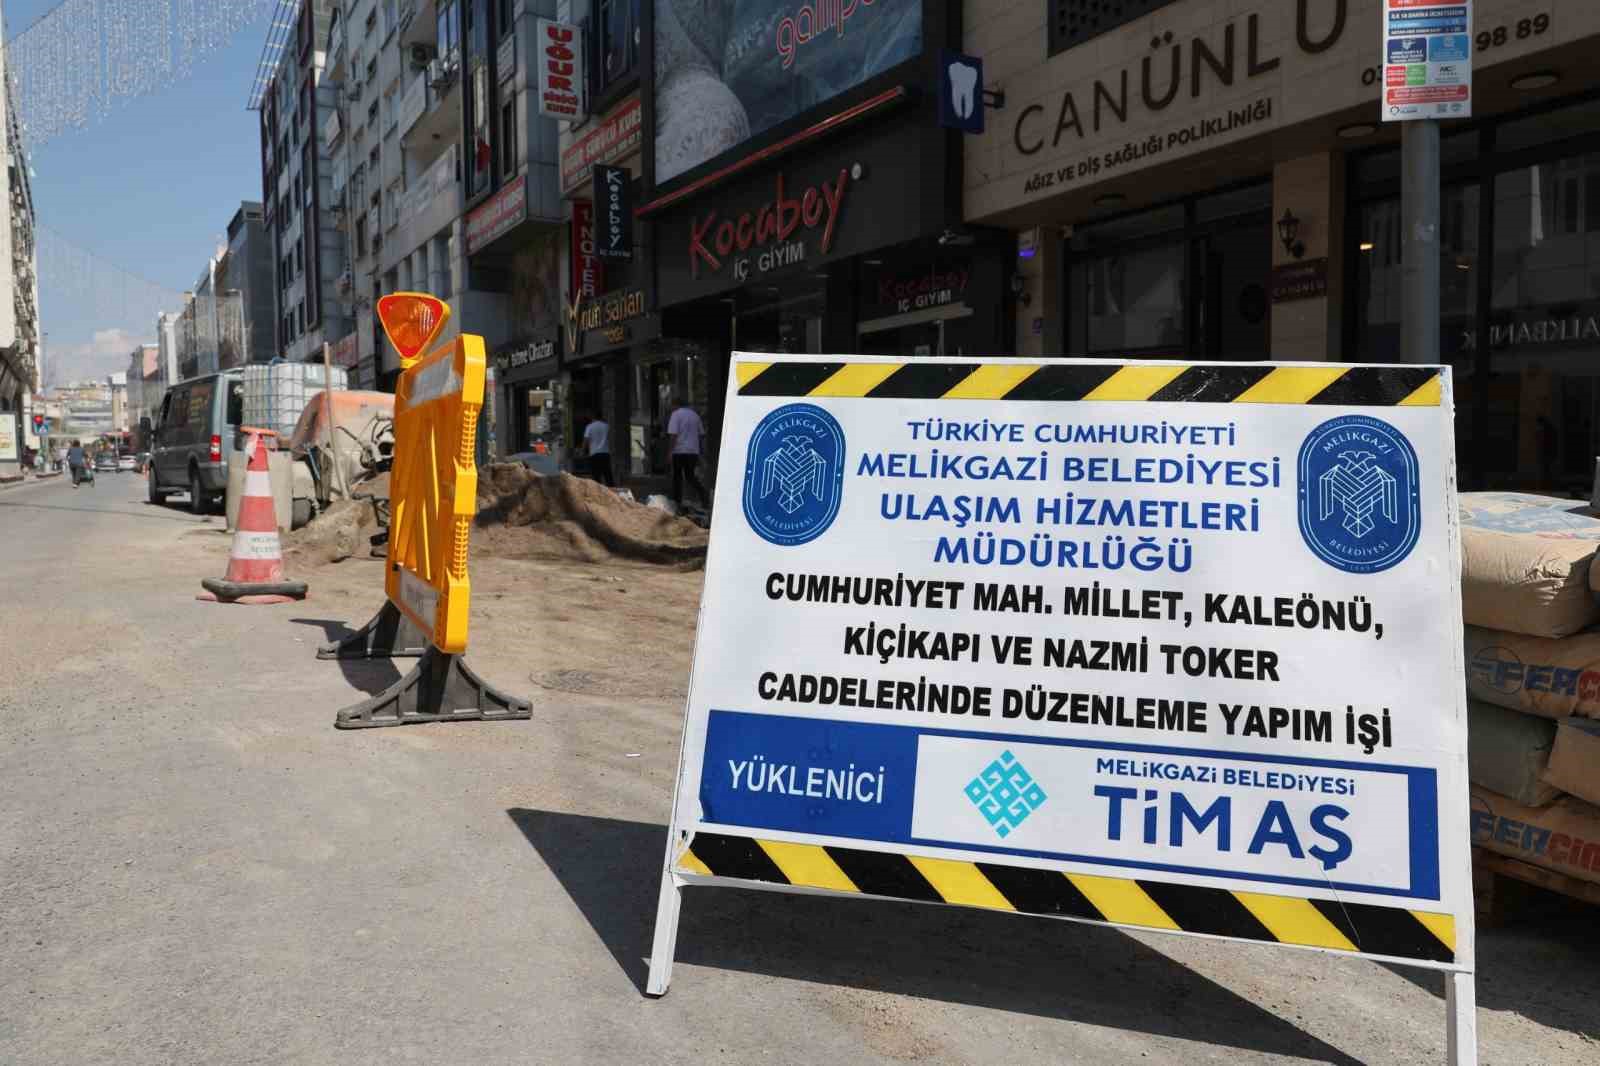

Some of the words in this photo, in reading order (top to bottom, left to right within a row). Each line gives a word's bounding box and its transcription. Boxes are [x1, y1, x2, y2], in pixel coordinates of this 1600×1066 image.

[1475, 26, 1507, 51] 98
[1516, 13, 1550, 39] 89
[1023, 172, 1054, 193] AĞIZ
[1057, 166, 1075, 185] VE
[1077, 156, 1102, 179] DİŞ
[1104, 136, 1164, 170] SAĞLIĞI
[1166, 97, 1273, 150] POLİKLİNİĞİ
[606, 169, 624, 249] Kocabey
[691, 166, 848, 279] Kocabey
[734, 258, 749, 282] İÇ
[758, 241, 804, 272] GİYİM
[907, 418, 1025, 443] TÜRKİYE
[1034, 420, 1235, 446] CUMHURİYETİ
[856, 448, 1048, 481] MELİKGAZİ
[1063, 453, 1280, 488] BELEDİYESİ
[880, 493, 1021, 528] ULAŞIM
[1036, 491, 1259, 532] HİZMETLERİ
[933, 531, 1192, 573] MÜDÜRLÜĞÜ
[765, 571, 965, 610] CUMHURİYET
[973, 582, 1053, 615] MAH.
[1063, 580, 1193, 629] MİLLET,
[1204, 592, 1384, 641] KALEÖNÜ,
[843, 620, 981, 665] KİÇİKAPI
[990, 634, 1033, 666] VE
[1043, 635, 1149, 673] NAZMİ
[1159, 644, 1281, 682] TOKER
[757, 671, 992, 717] CADDELERİNDE
[1001, 683, 1208, 734] DÜZENLEME
[1218, 703, 1333, 744] YAPIM
[1345, 704, 1393, 755] İŞİ
[728, 754, 885, 804] YÜKLENİCİ
